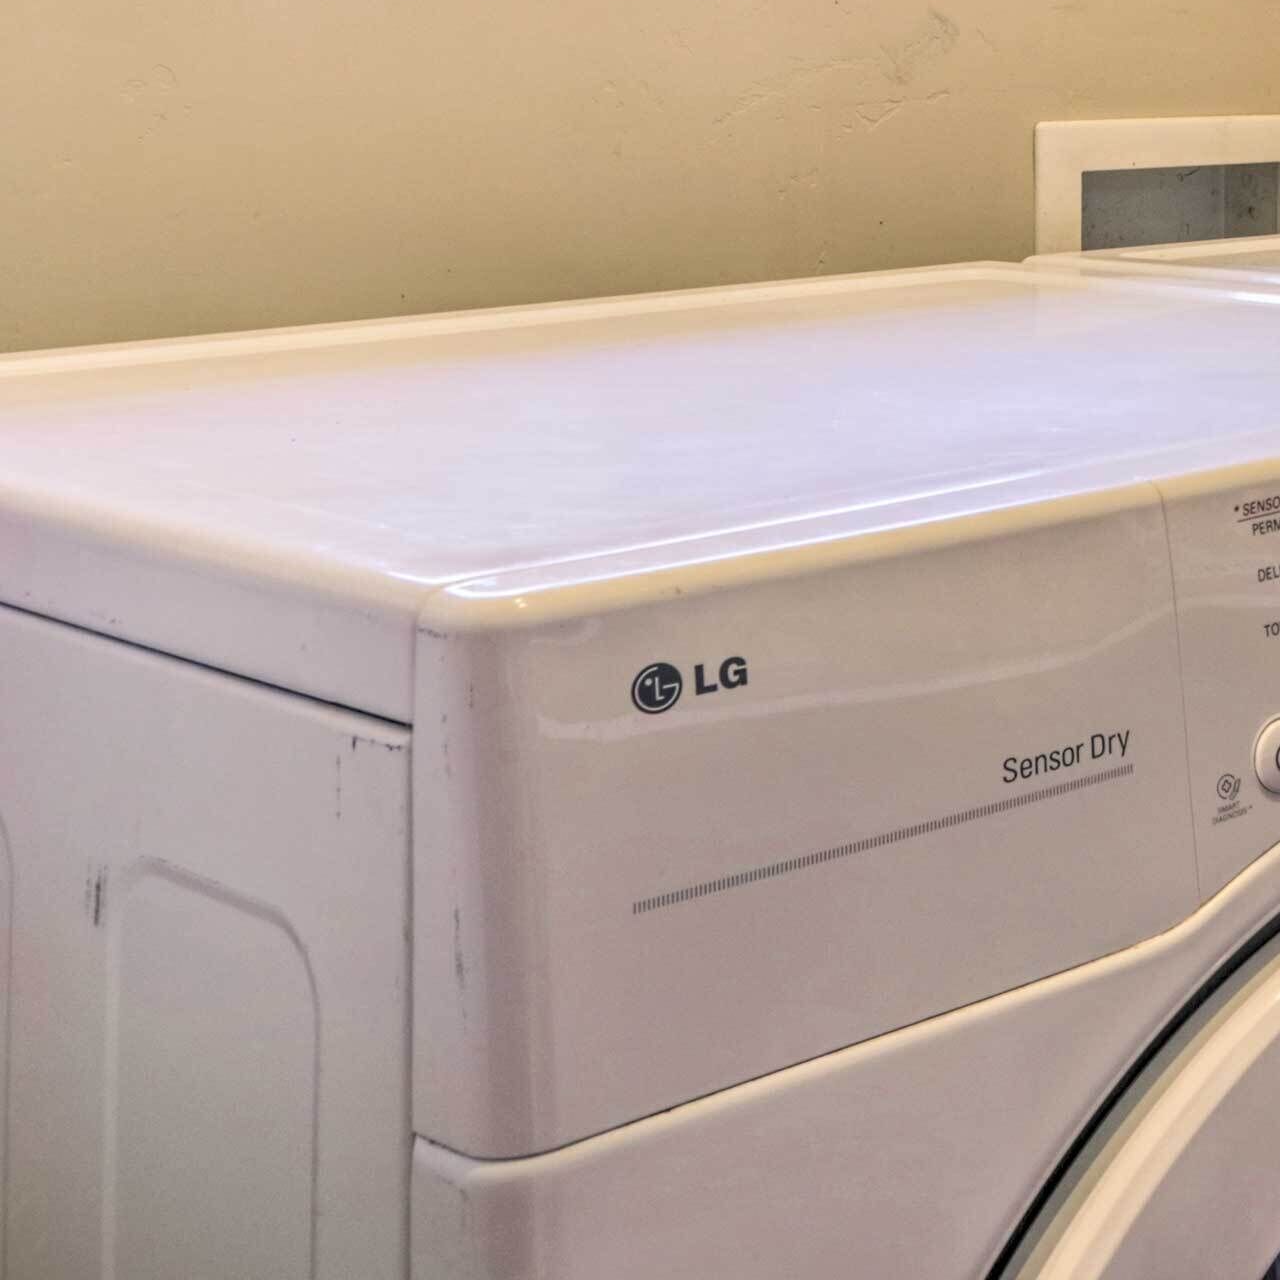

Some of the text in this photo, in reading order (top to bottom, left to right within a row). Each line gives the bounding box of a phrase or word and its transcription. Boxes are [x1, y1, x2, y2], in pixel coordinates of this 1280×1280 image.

[694, 656, 749, 696] LG
[1002, 730, 1131, 784] Sensor Dry
